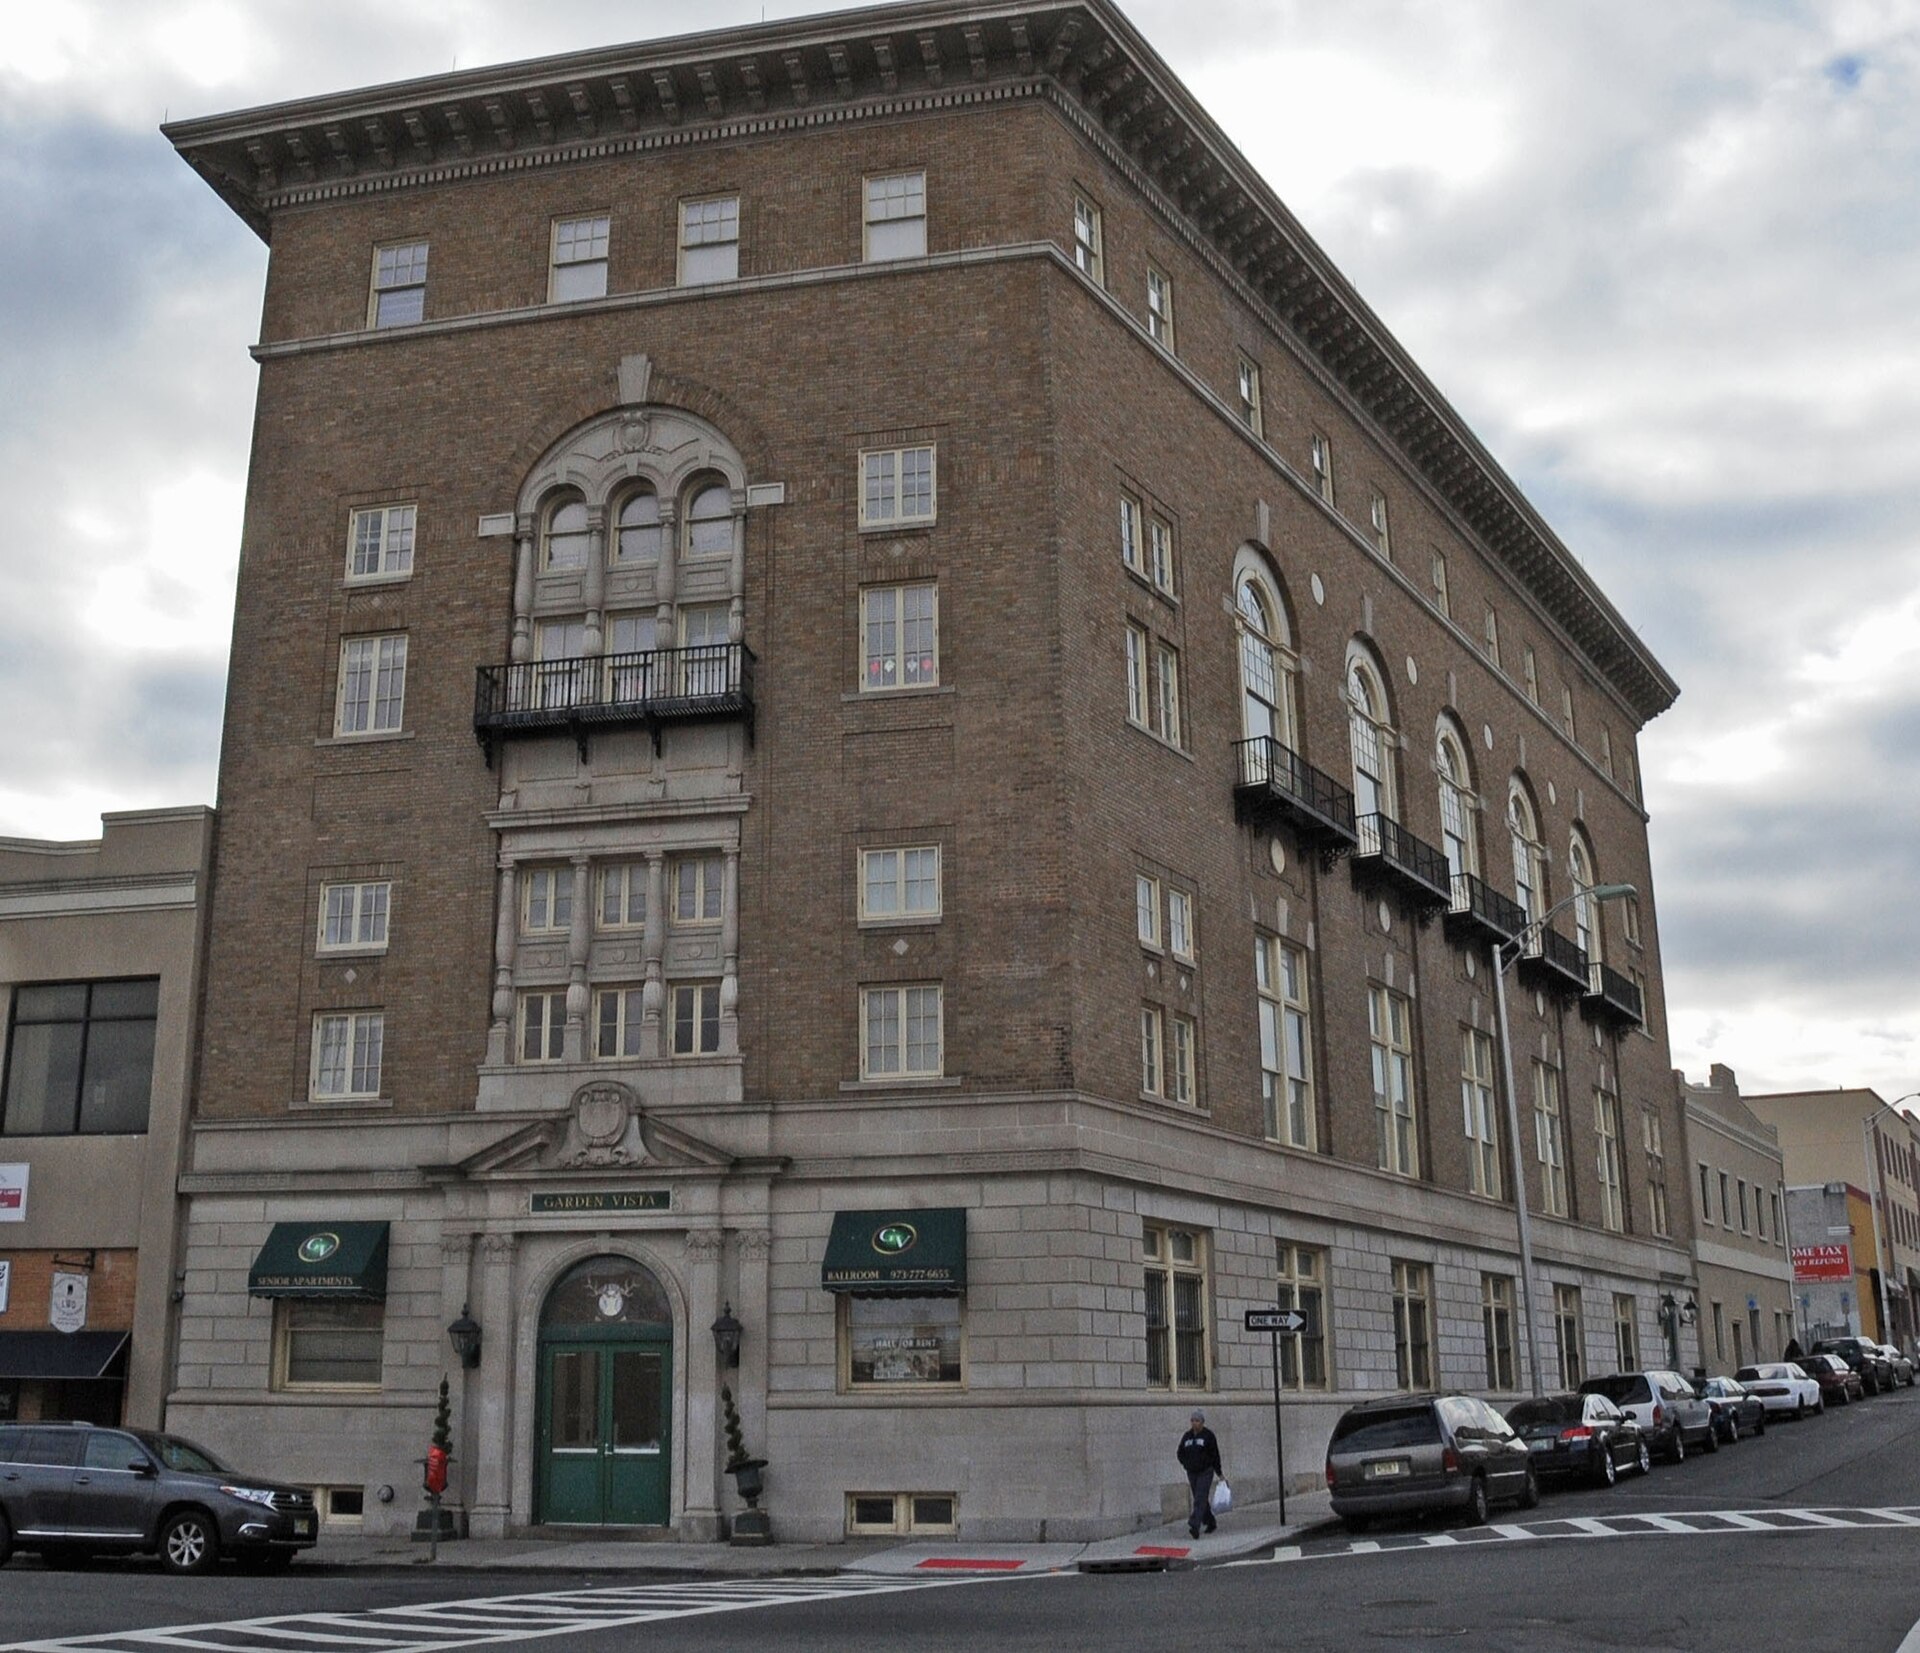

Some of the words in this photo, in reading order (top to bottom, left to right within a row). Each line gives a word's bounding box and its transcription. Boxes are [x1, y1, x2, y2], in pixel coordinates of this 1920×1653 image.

[543, 1195, 604, 1209] GARDEN
[612, 1194, 655, 1207] VISTA
[1818, 1246, 1842, 1256] TAX
[1808, 1257, 1845, 1266] REFUND
[827, 1270, 880, 1281] BALLROOM
[257, 1277, 290, 1286] SENIOR
[293, 1276, 354, 1286] APARTMENTS
[1250, 1316, 1268, 1325] ONE
[1271, 1316, 1288, 1325] WAY
